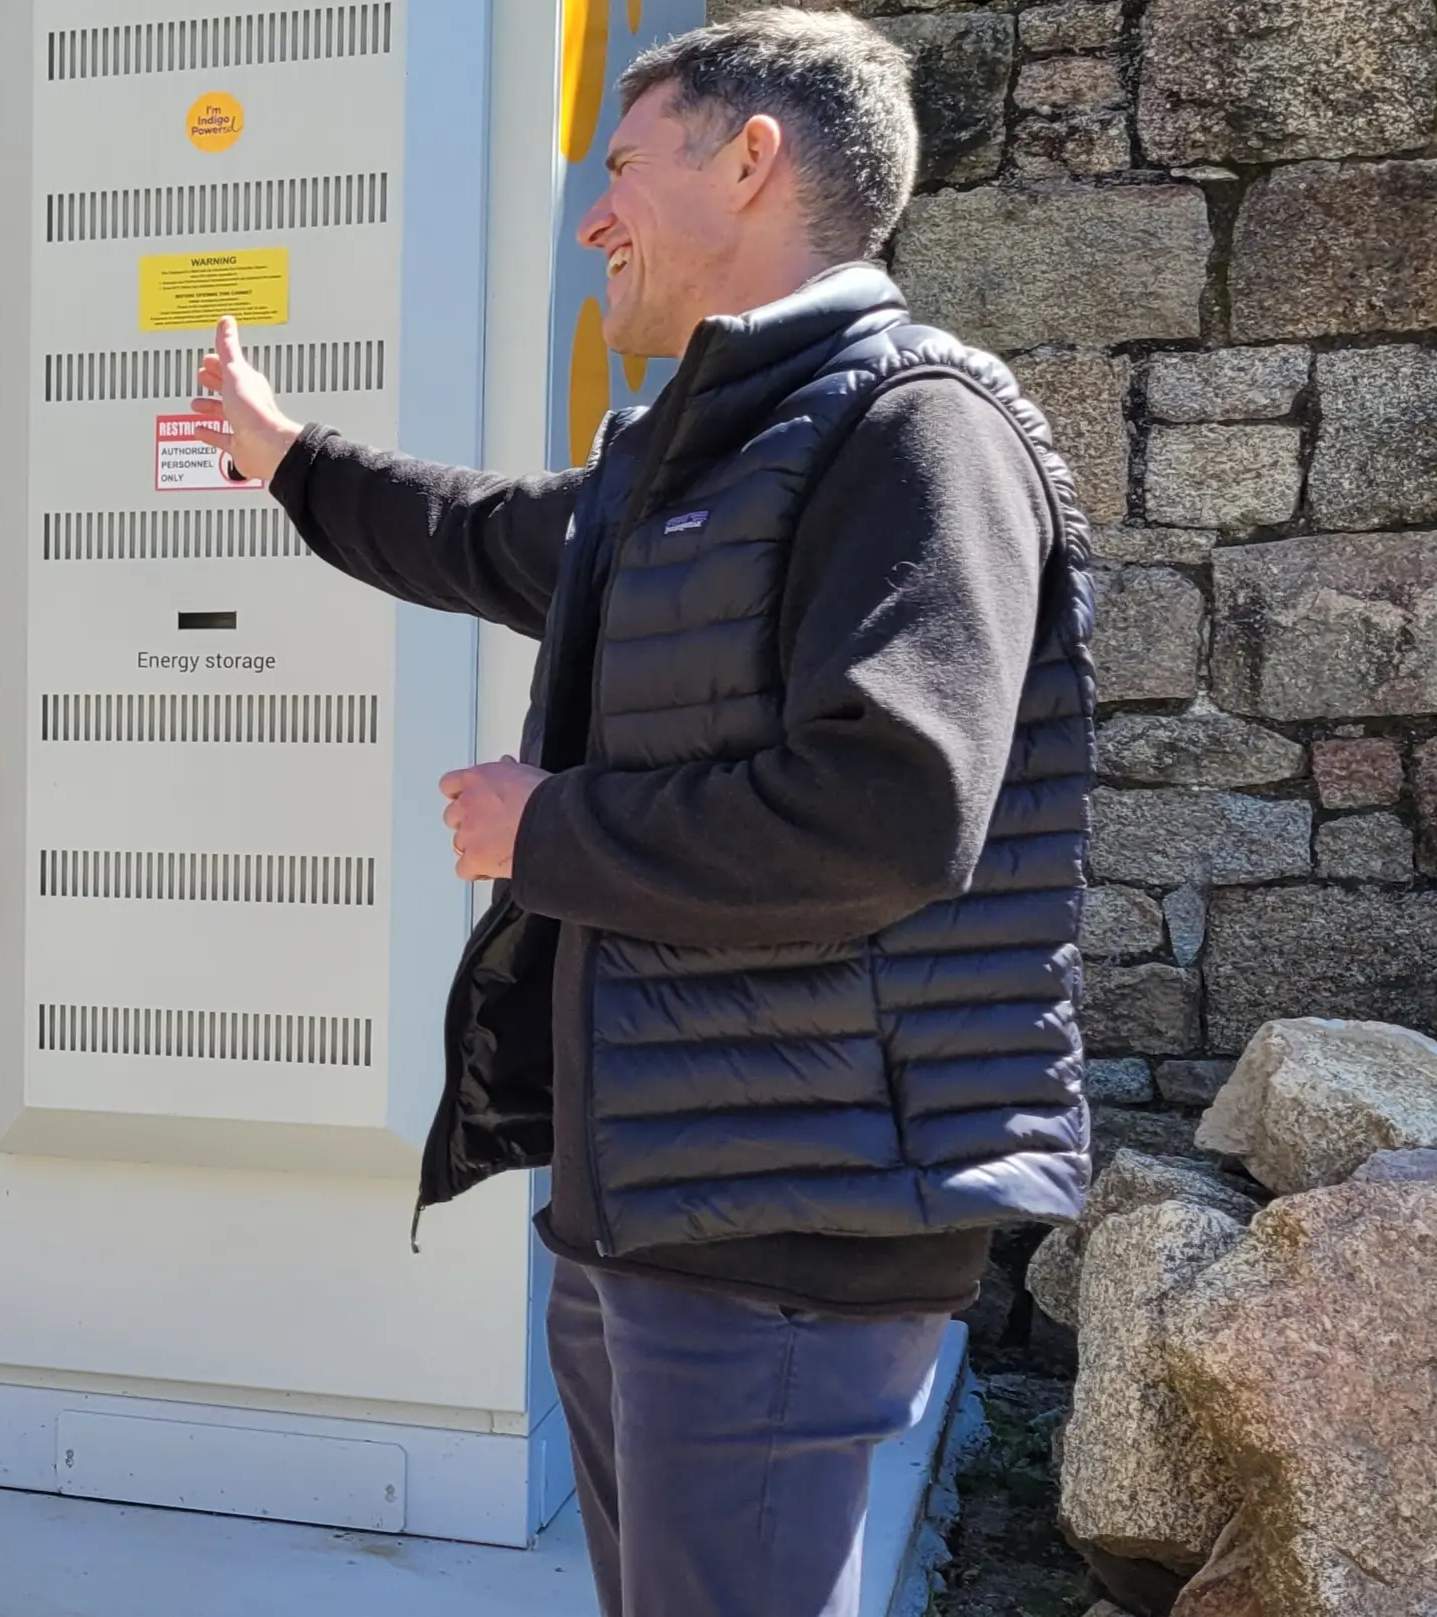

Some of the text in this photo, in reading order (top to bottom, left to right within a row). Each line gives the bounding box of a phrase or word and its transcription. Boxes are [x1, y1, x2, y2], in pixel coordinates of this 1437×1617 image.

[206, 105, 222, 115] I'm
[191, 116, 242, 136] Powered
[198, 116, 230, 126] Indigo
[191, 256, 237, 267] WARNING
[161, 447, 217, 456] AUTHORIZED
[161, 460, 214, 469] PERSONNEL
[161, 474, 184, 482] ONLY
[137, 651, 276, 673] Energy storage
